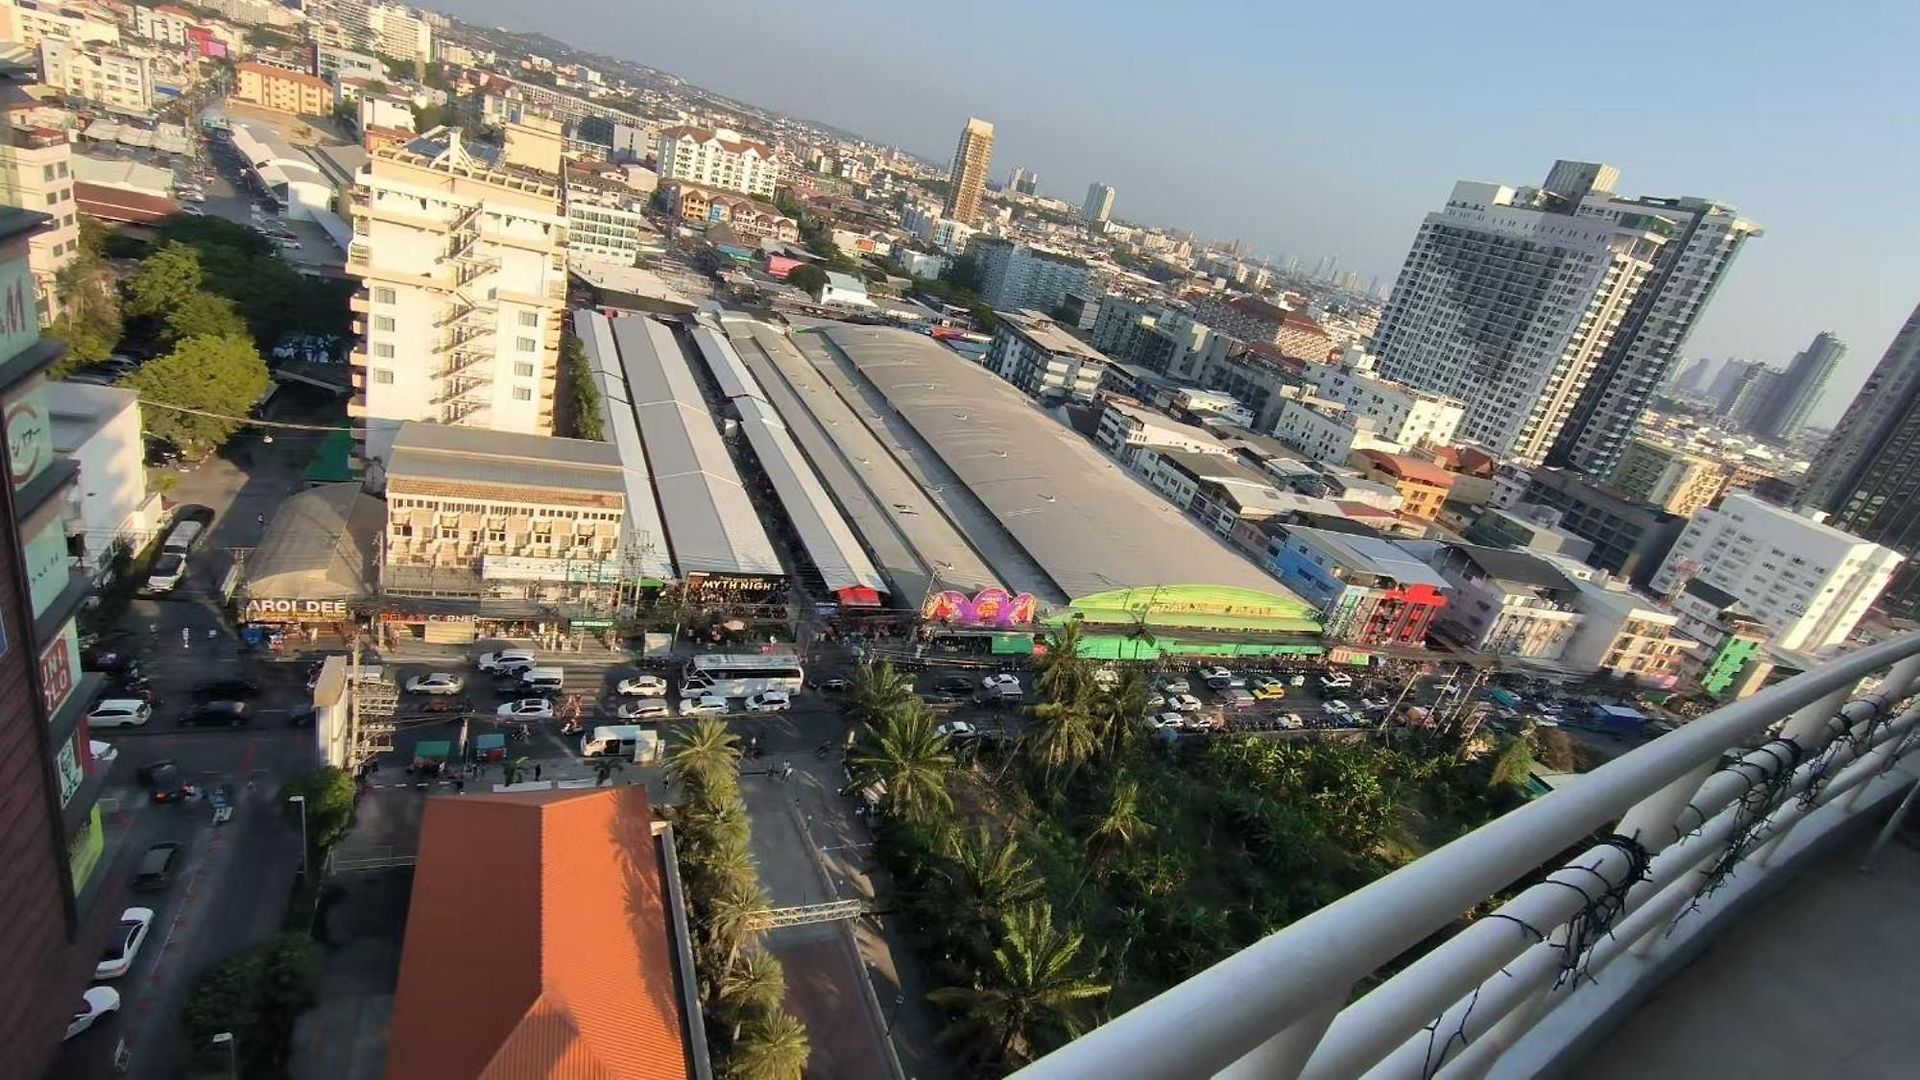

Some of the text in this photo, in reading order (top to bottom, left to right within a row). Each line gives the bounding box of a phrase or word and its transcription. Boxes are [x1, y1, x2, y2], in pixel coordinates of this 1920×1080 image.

[702, 579, 738, 590] MYTH
[740, 581, 778, 591] NIGHT
[246, 599, 347, 613] AROI DEE
